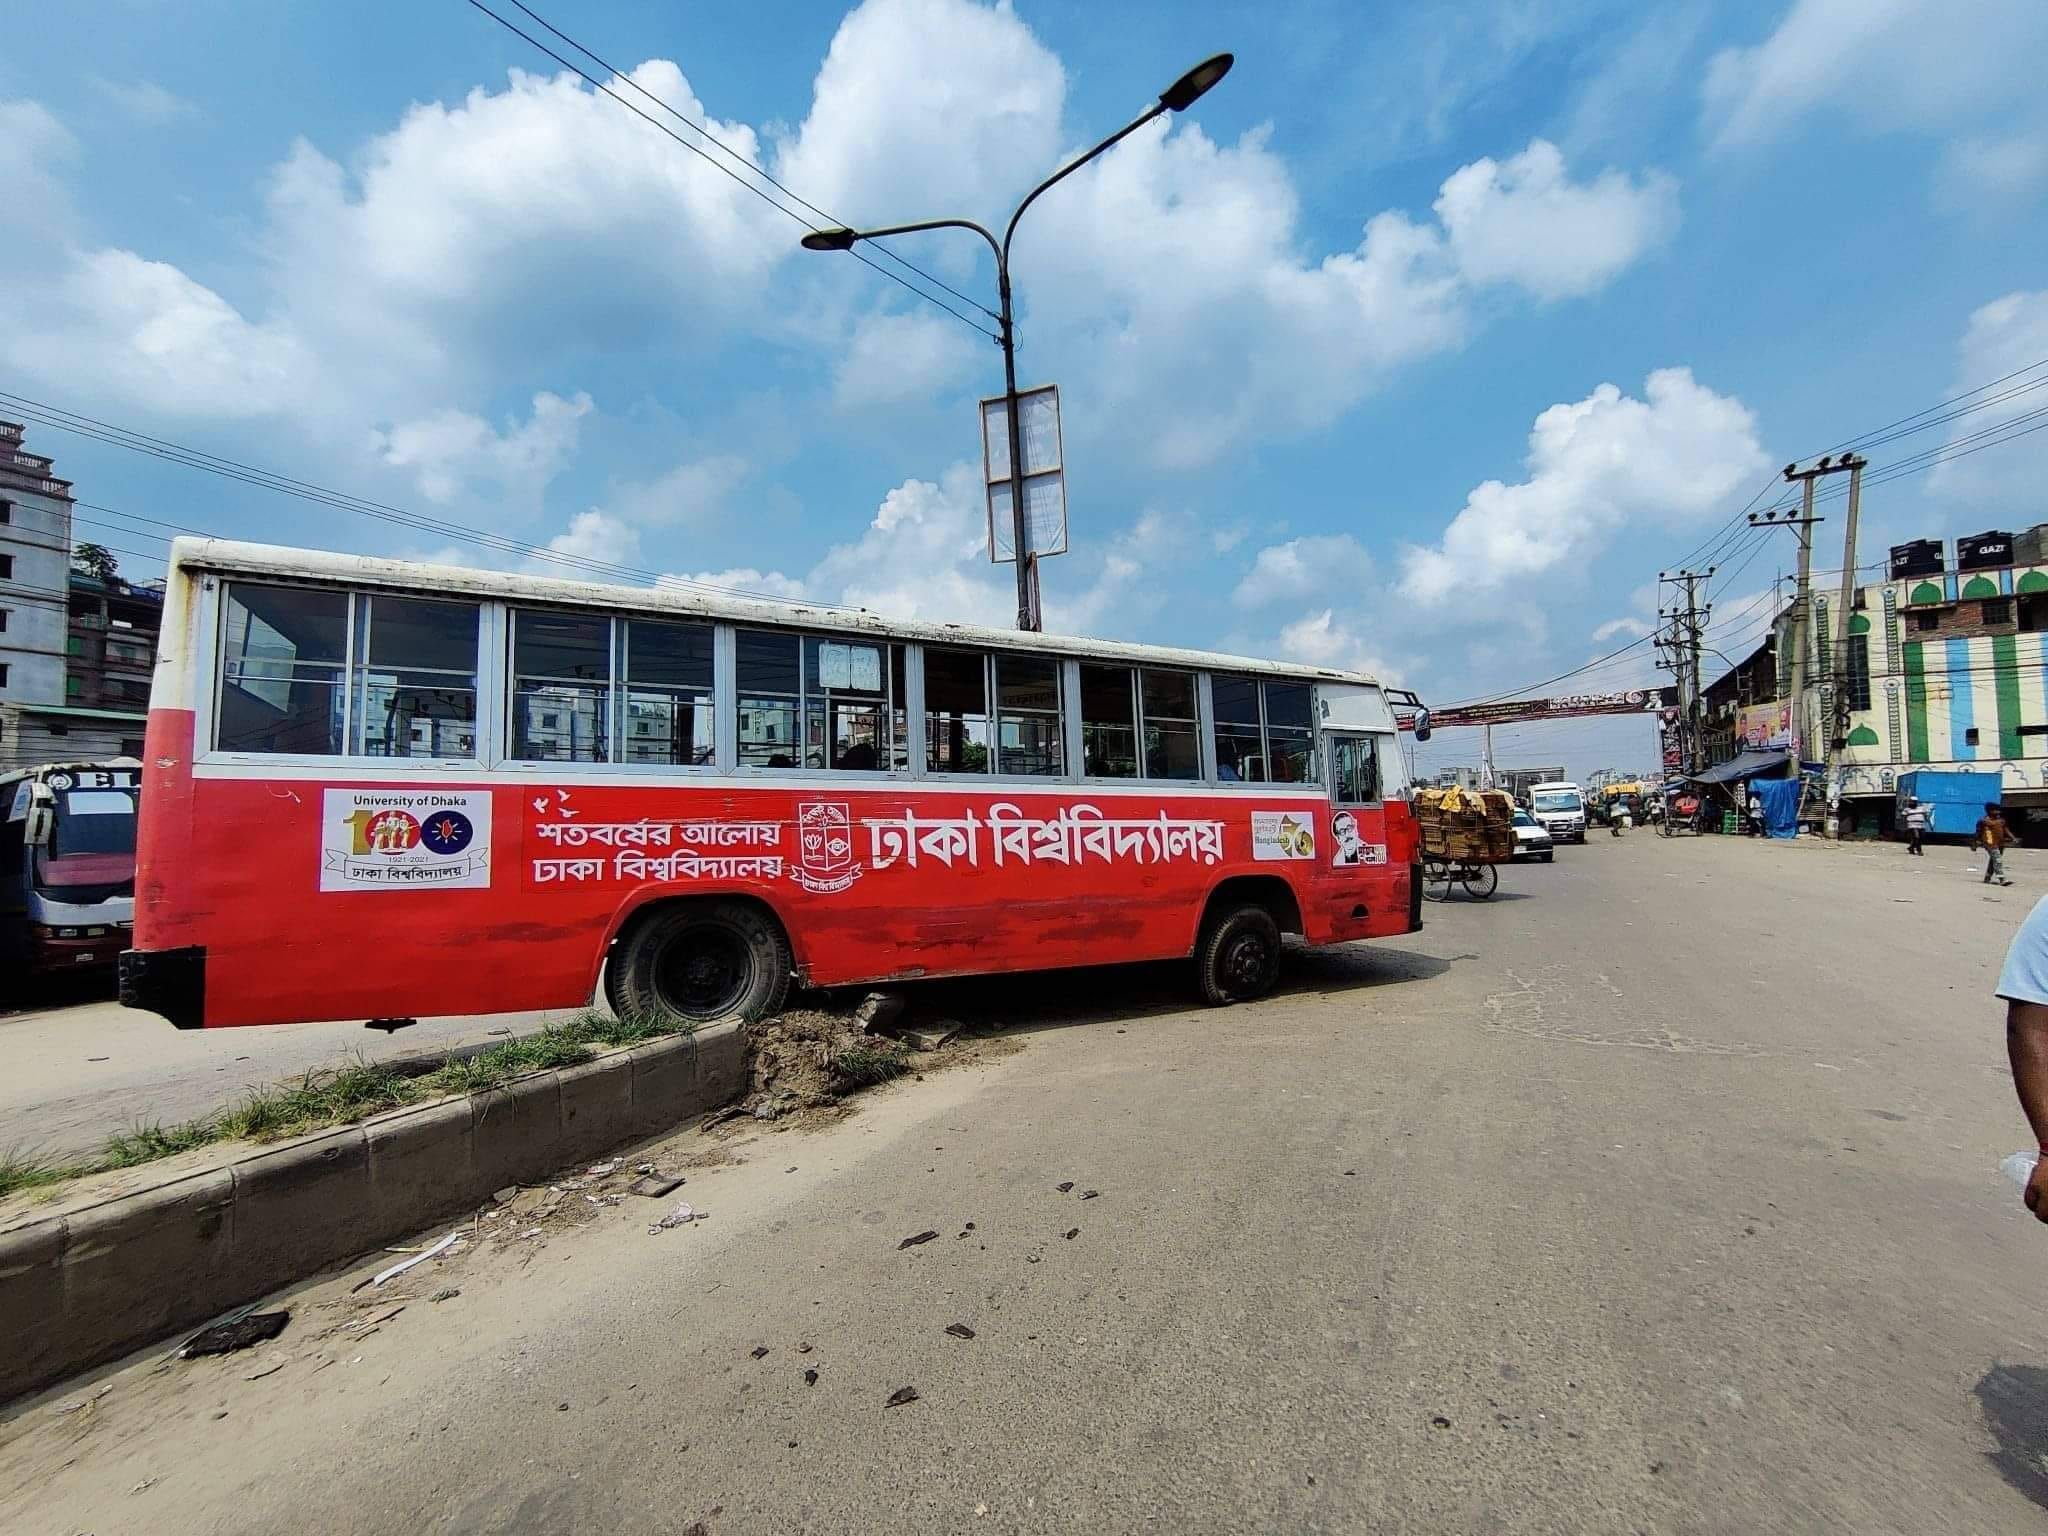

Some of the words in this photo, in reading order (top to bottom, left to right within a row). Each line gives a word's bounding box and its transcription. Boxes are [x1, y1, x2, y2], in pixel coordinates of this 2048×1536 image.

[1979, 544, 2006, 555] GAZI
[353, 795, 414, 808] University
[416, 795, 428, 806] of
[431, 796, 467, 806] Dhaka
[535, 818, 672, 847] শতবর্ষের
[680, 822, 782, 847] আলোয়
[861, 808, 983, 869] ঢাকা
[984, 802, 1225, 866] বিশ্ববিদ্যালয়
[352, 867, 382, 880] ঢাকা
[387, 866, 462, 880] বিশ্ববিদ্যালয়
[533, 857, 605, 882] ঢাকা
[613, 849, 784, 882] বিশ্ববিদ্যালয়
